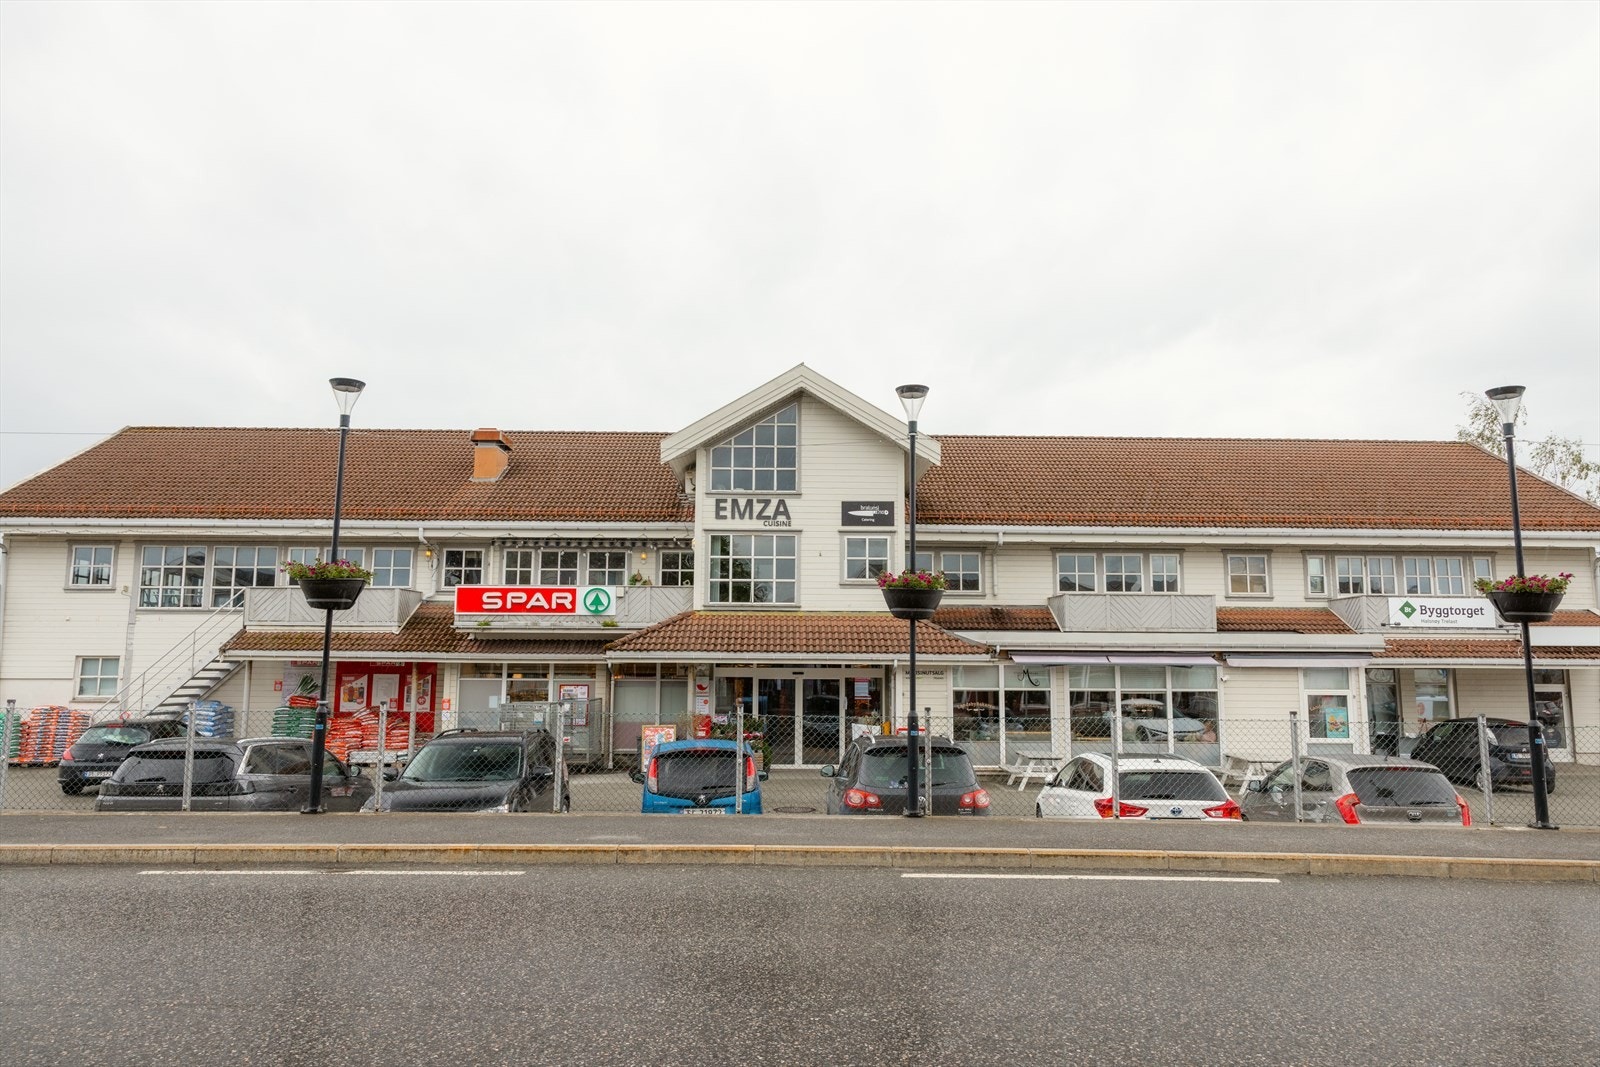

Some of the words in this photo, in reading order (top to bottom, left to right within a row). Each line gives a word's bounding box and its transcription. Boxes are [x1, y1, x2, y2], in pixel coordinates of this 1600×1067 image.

[715, 498, 791, 520] EMZA
[482, 592, 573, 609] SPAR
[1419, 605, 1485, 618] Byggtorget
